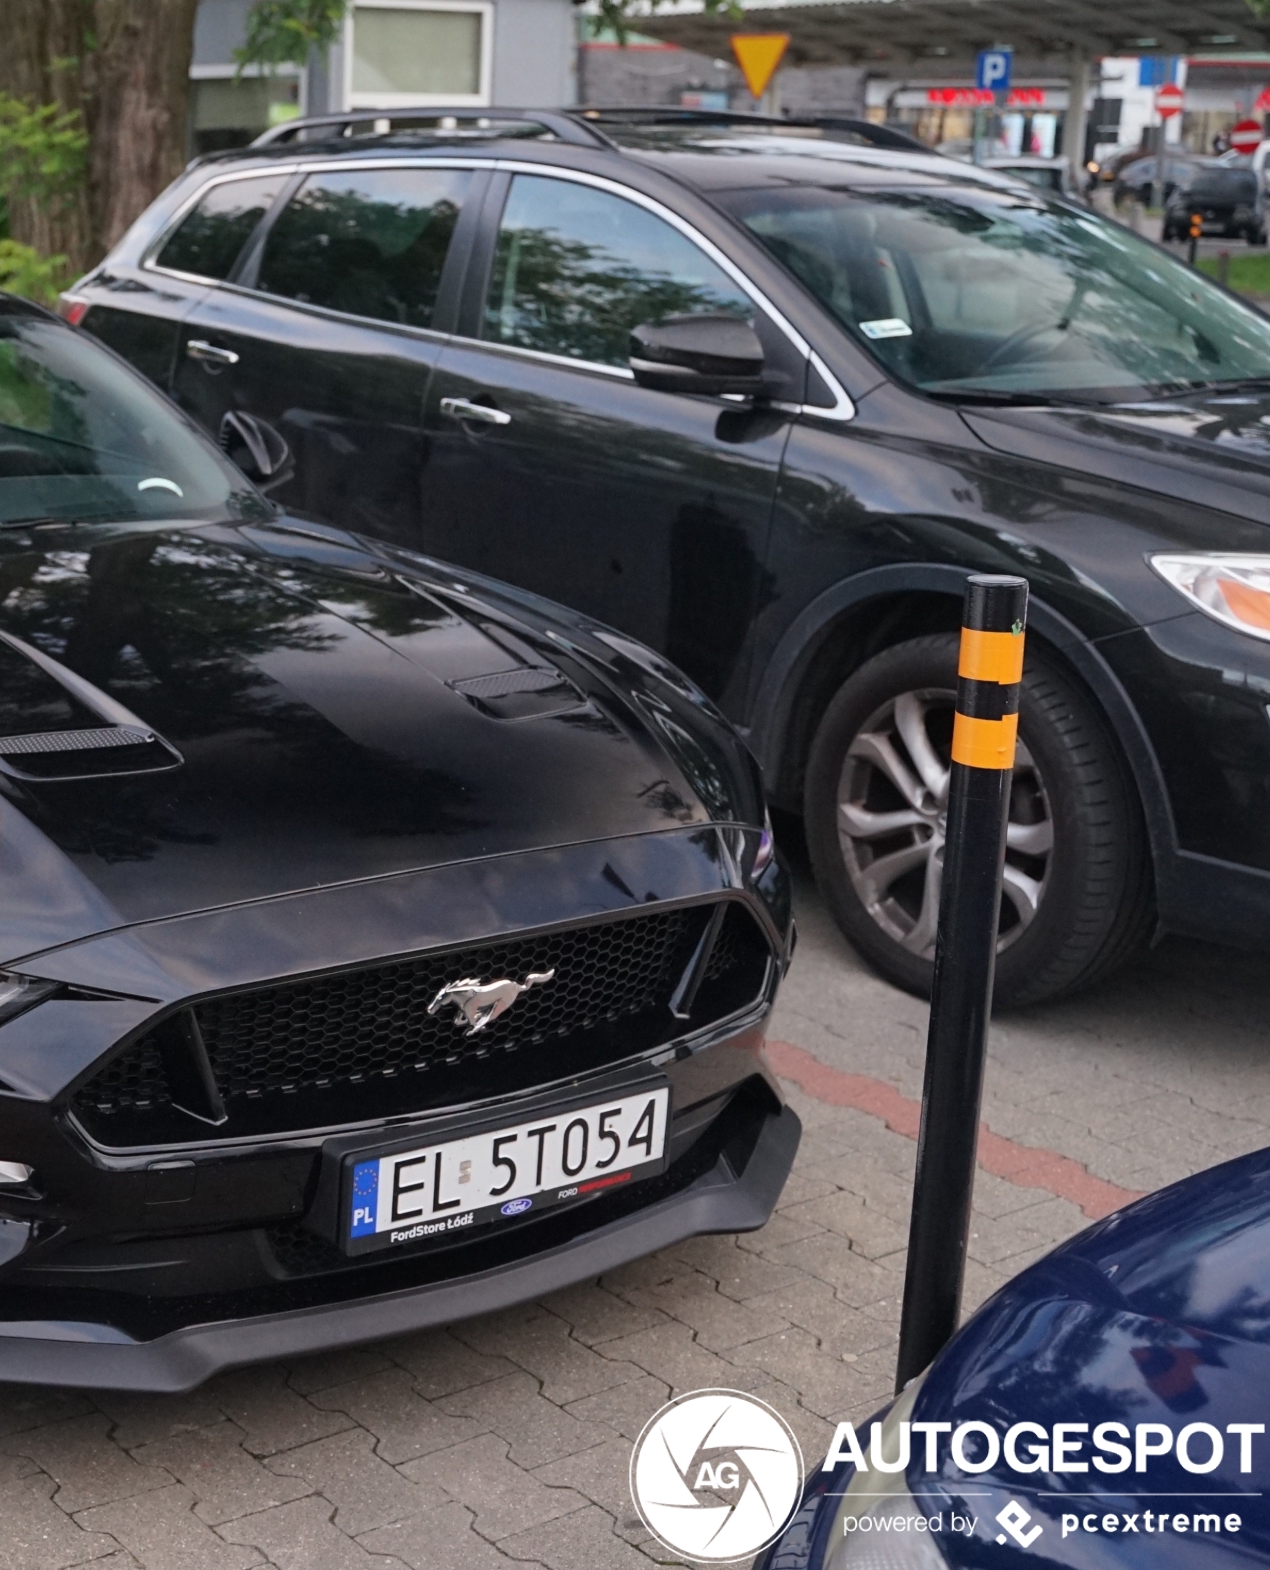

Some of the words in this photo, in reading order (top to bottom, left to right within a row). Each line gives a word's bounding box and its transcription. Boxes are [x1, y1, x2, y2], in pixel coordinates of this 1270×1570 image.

[982, 53, 1006, 88] P
[391, 1152, 461, 1222] EL
[489, 1099, 657, 1196] 5T054
[557, 1187, 579, 1200] FORD
[353, 1207, 374, 1227] PL
[390, 1221, 446, 1243] FordStore
[447, 1212, 474, 1229] Łódź
